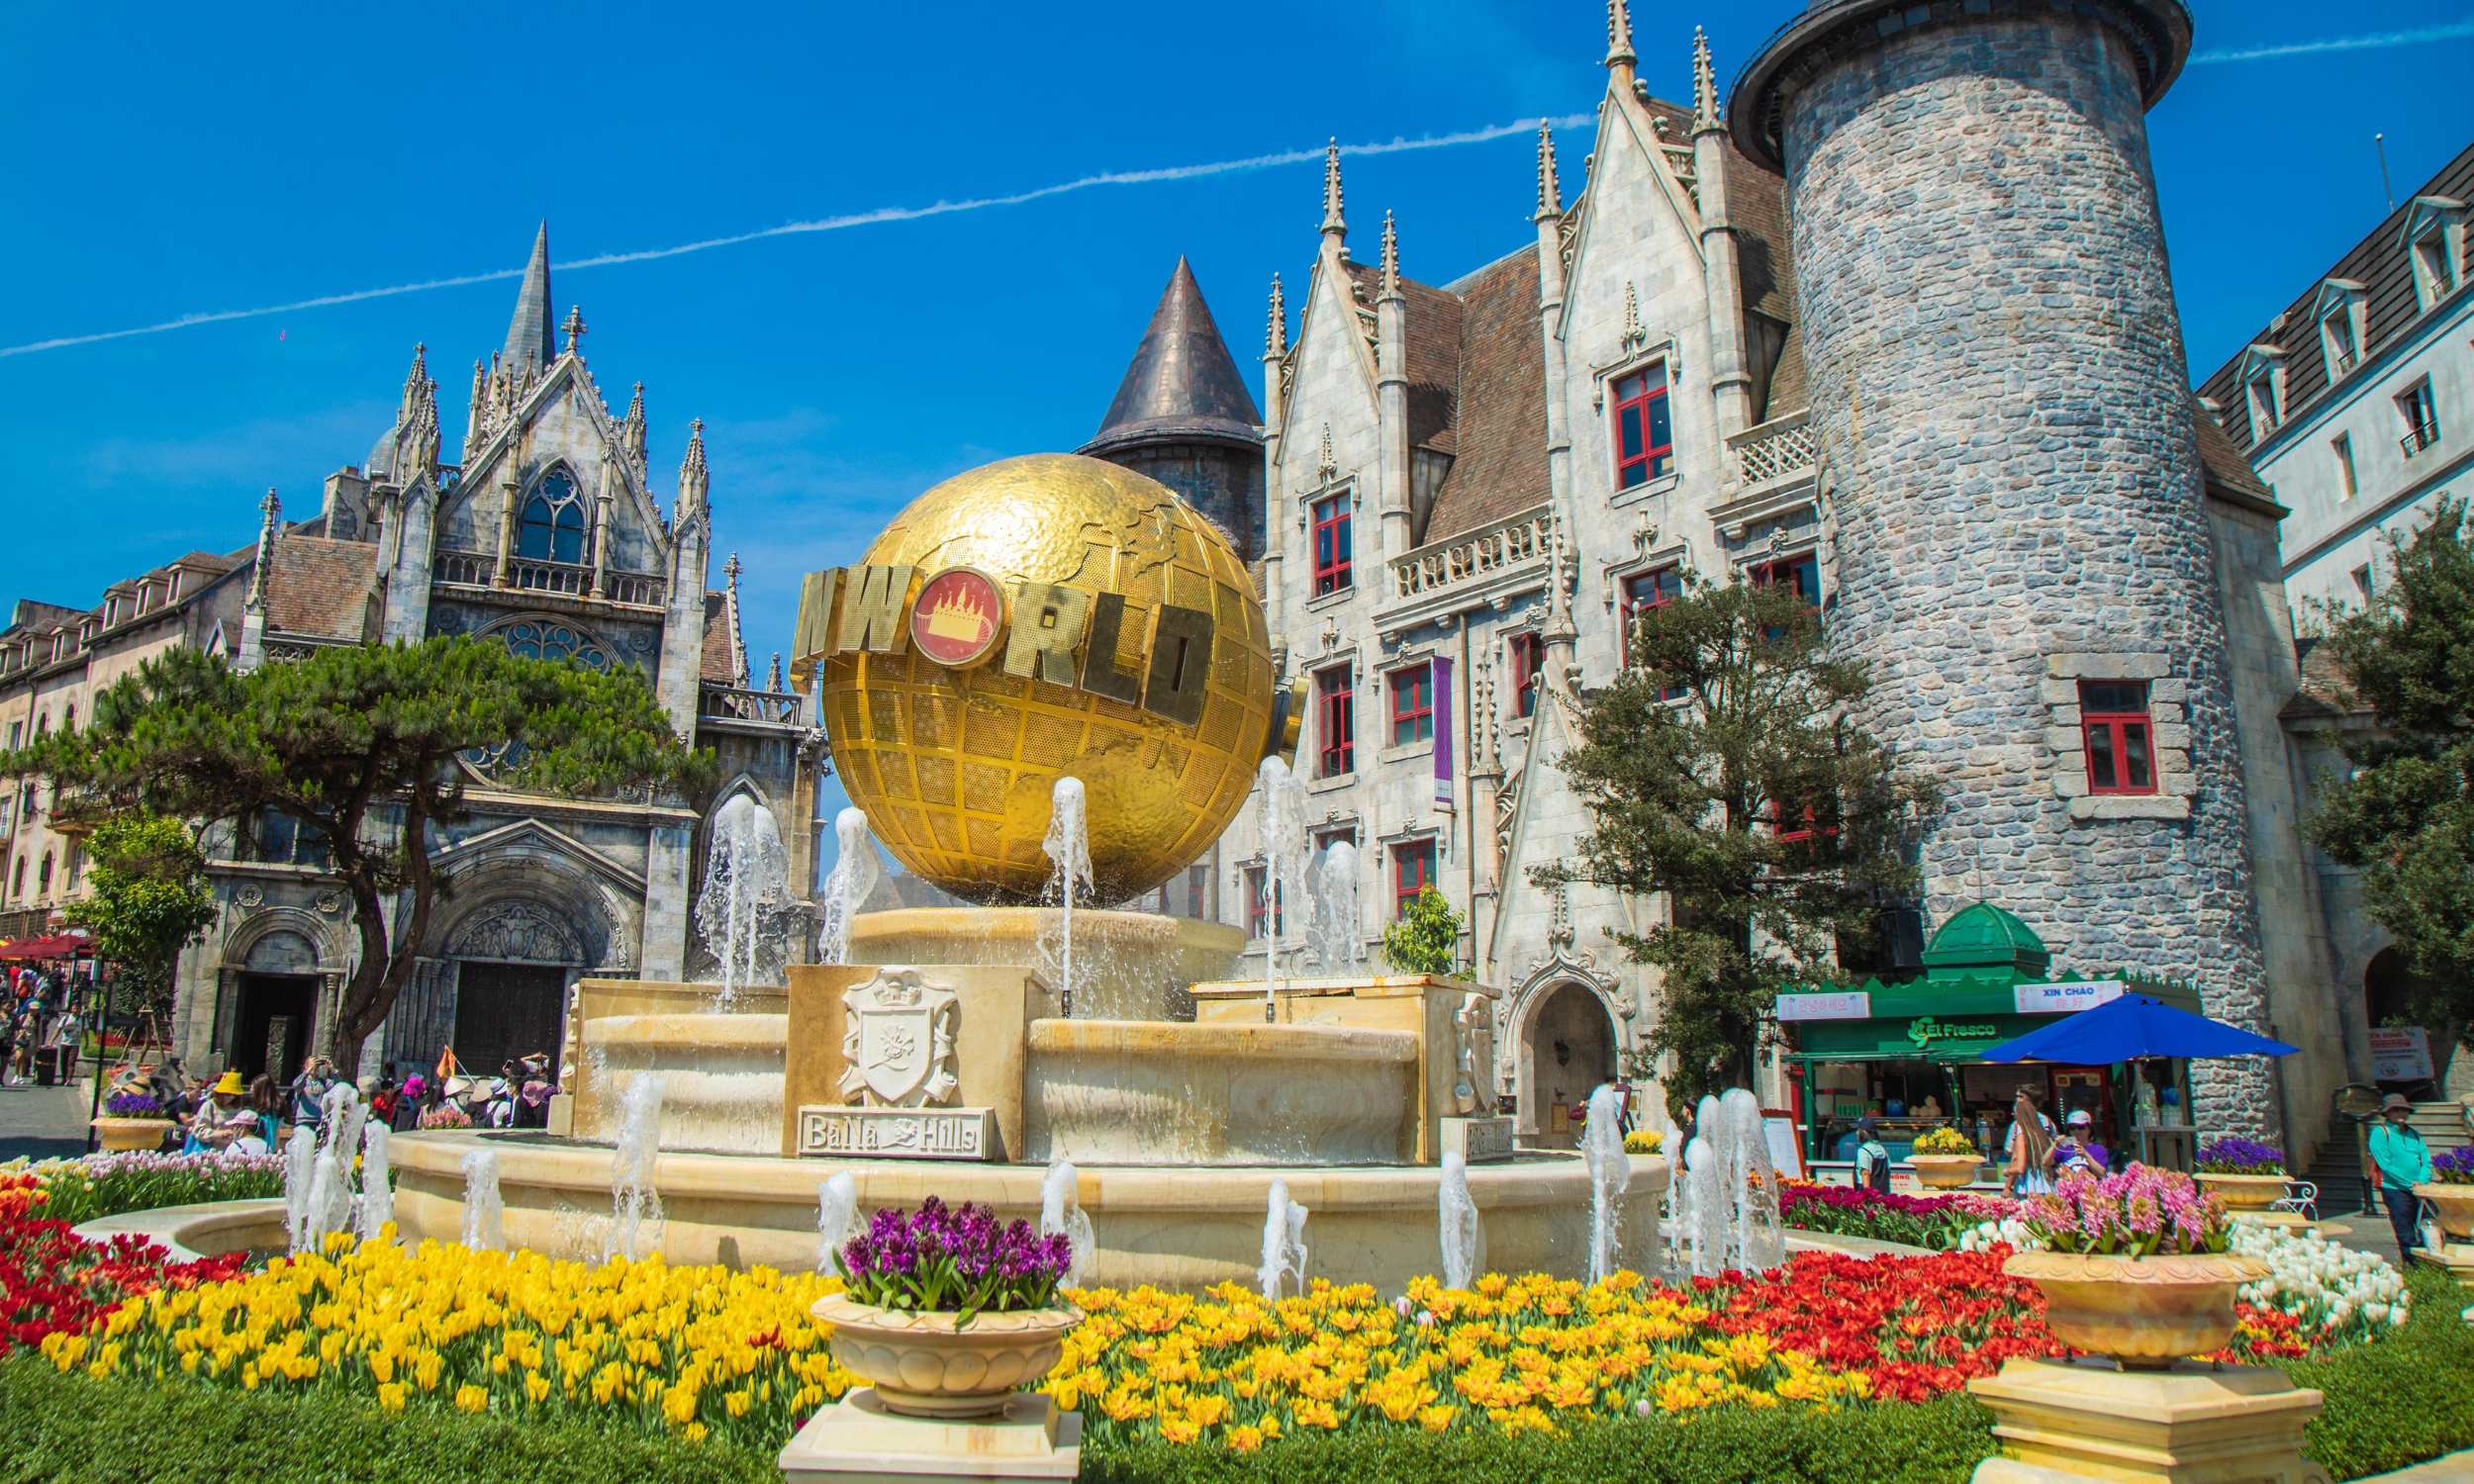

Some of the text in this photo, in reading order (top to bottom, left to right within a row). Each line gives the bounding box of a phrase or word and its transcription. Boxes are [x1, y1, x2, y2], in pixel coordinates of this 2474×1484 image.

[2043, 985, 2095, 997] XIN CHÀO
[1798, 998, 1848, 1013] 안녕하세요
[1944, 1023, 1997, 1038] Fresco
[918, 1117, 977, 1154] Hills
